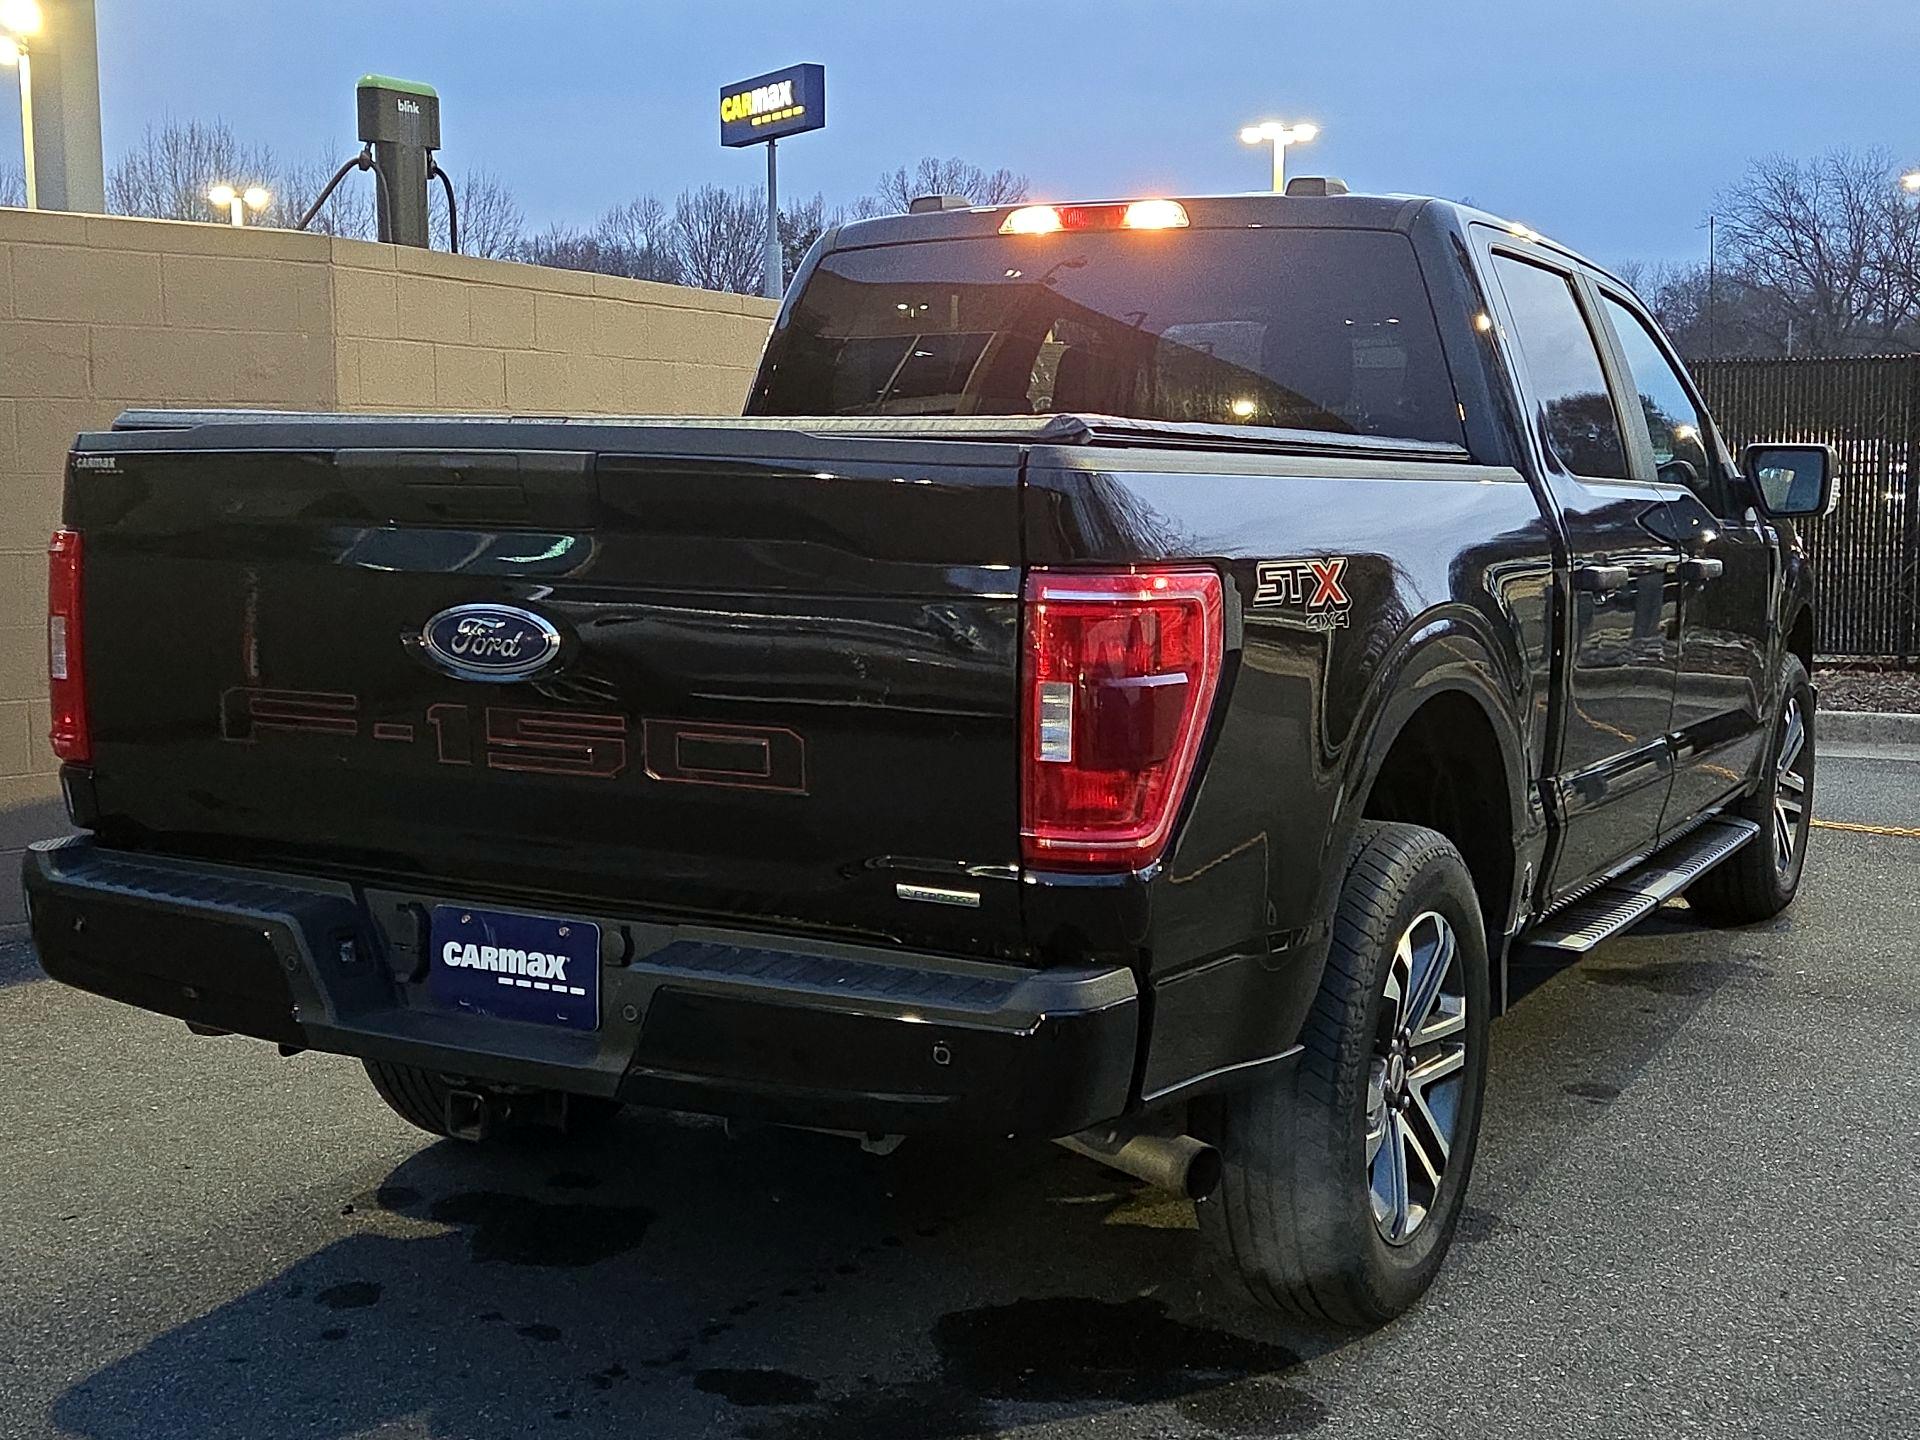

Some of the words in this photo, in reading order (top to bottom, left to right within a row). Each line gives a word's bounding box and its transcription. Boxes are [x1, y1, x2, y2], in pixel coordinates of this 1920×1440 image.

[397, 98, 420, 115] blink
[1253, 556, 1353, 615] STX
[450, 616, 524, 658] Ford
[221, 686, 811, 796] F-150
